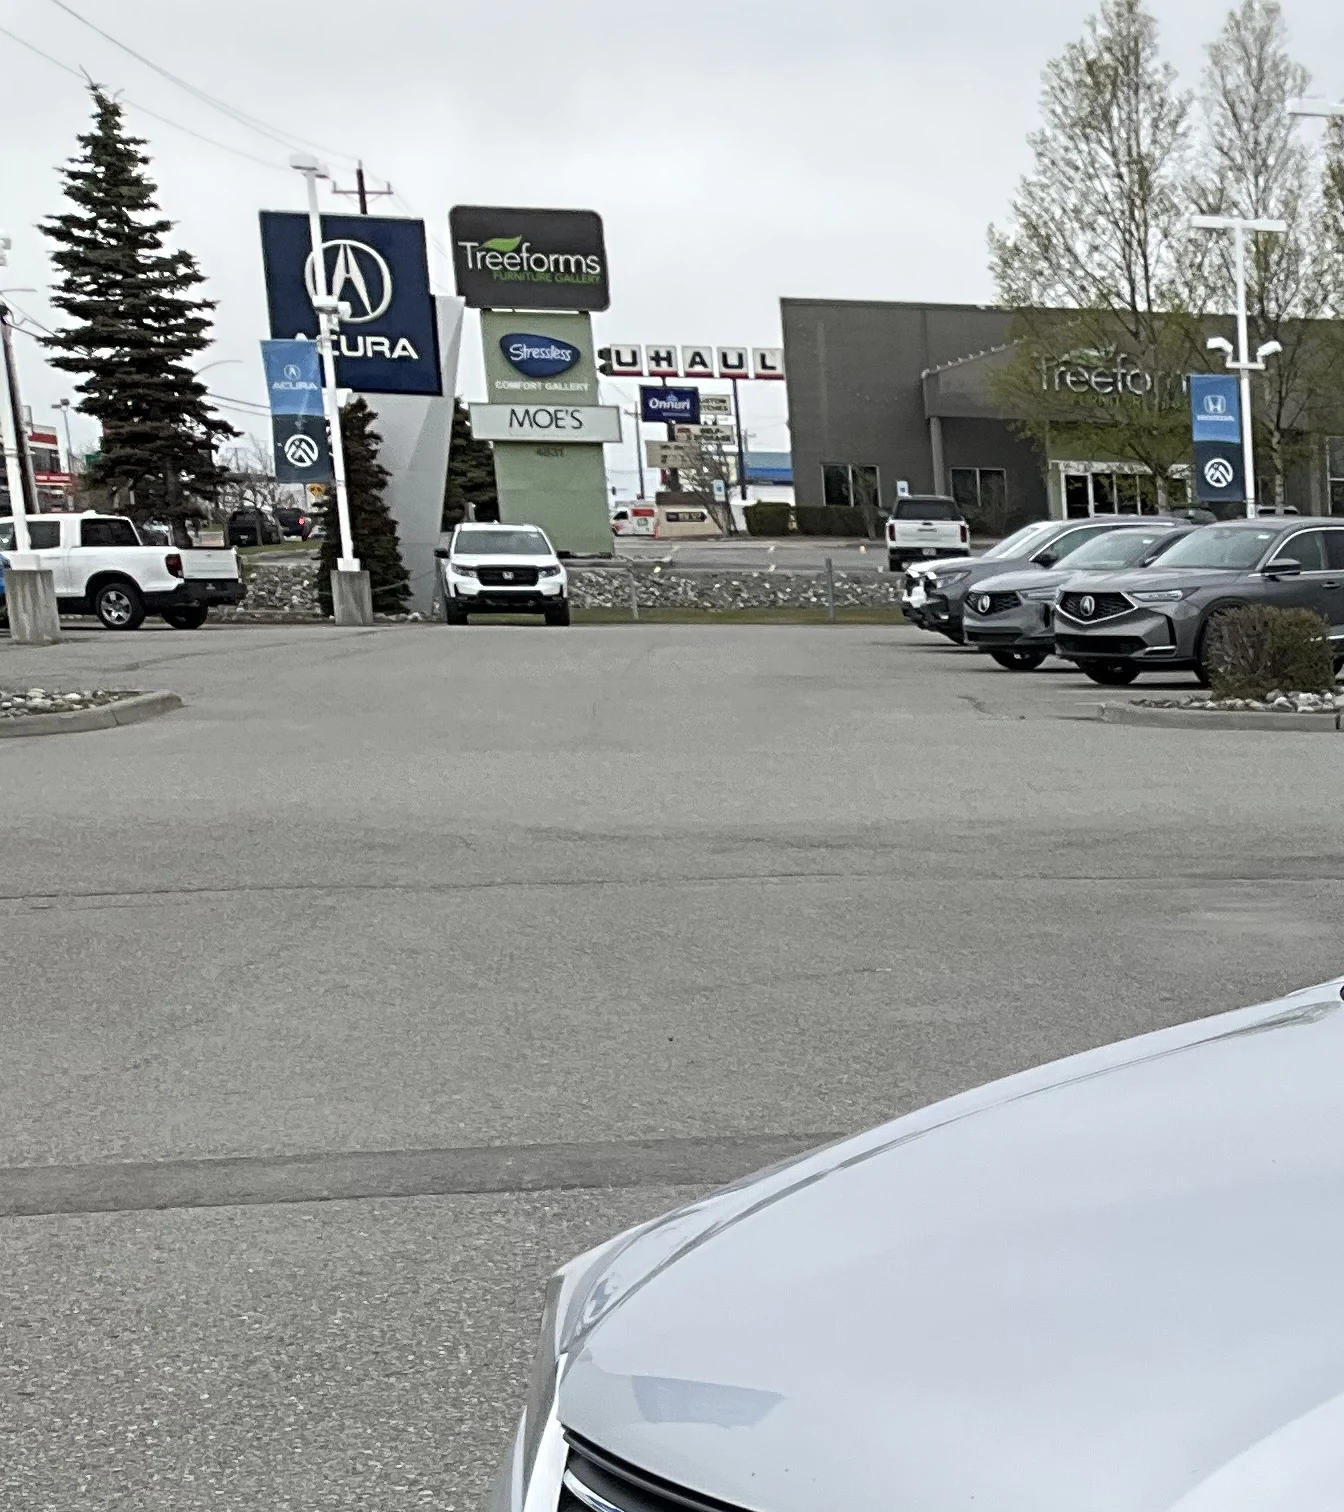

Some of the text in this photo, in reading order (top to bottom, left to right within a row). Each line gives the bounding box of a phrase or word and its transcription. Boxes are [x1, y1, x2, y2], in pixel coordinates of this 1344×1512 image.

[458, 241, 600, 275] Treeforms
[493, 271, 600, 285] FURNITURE GALLERY
[509, 343, 572, 361] Stressless
[495, 380, 589, 391] COMFORT GALLERY
[509, 408, 583, 430] MOE'S
